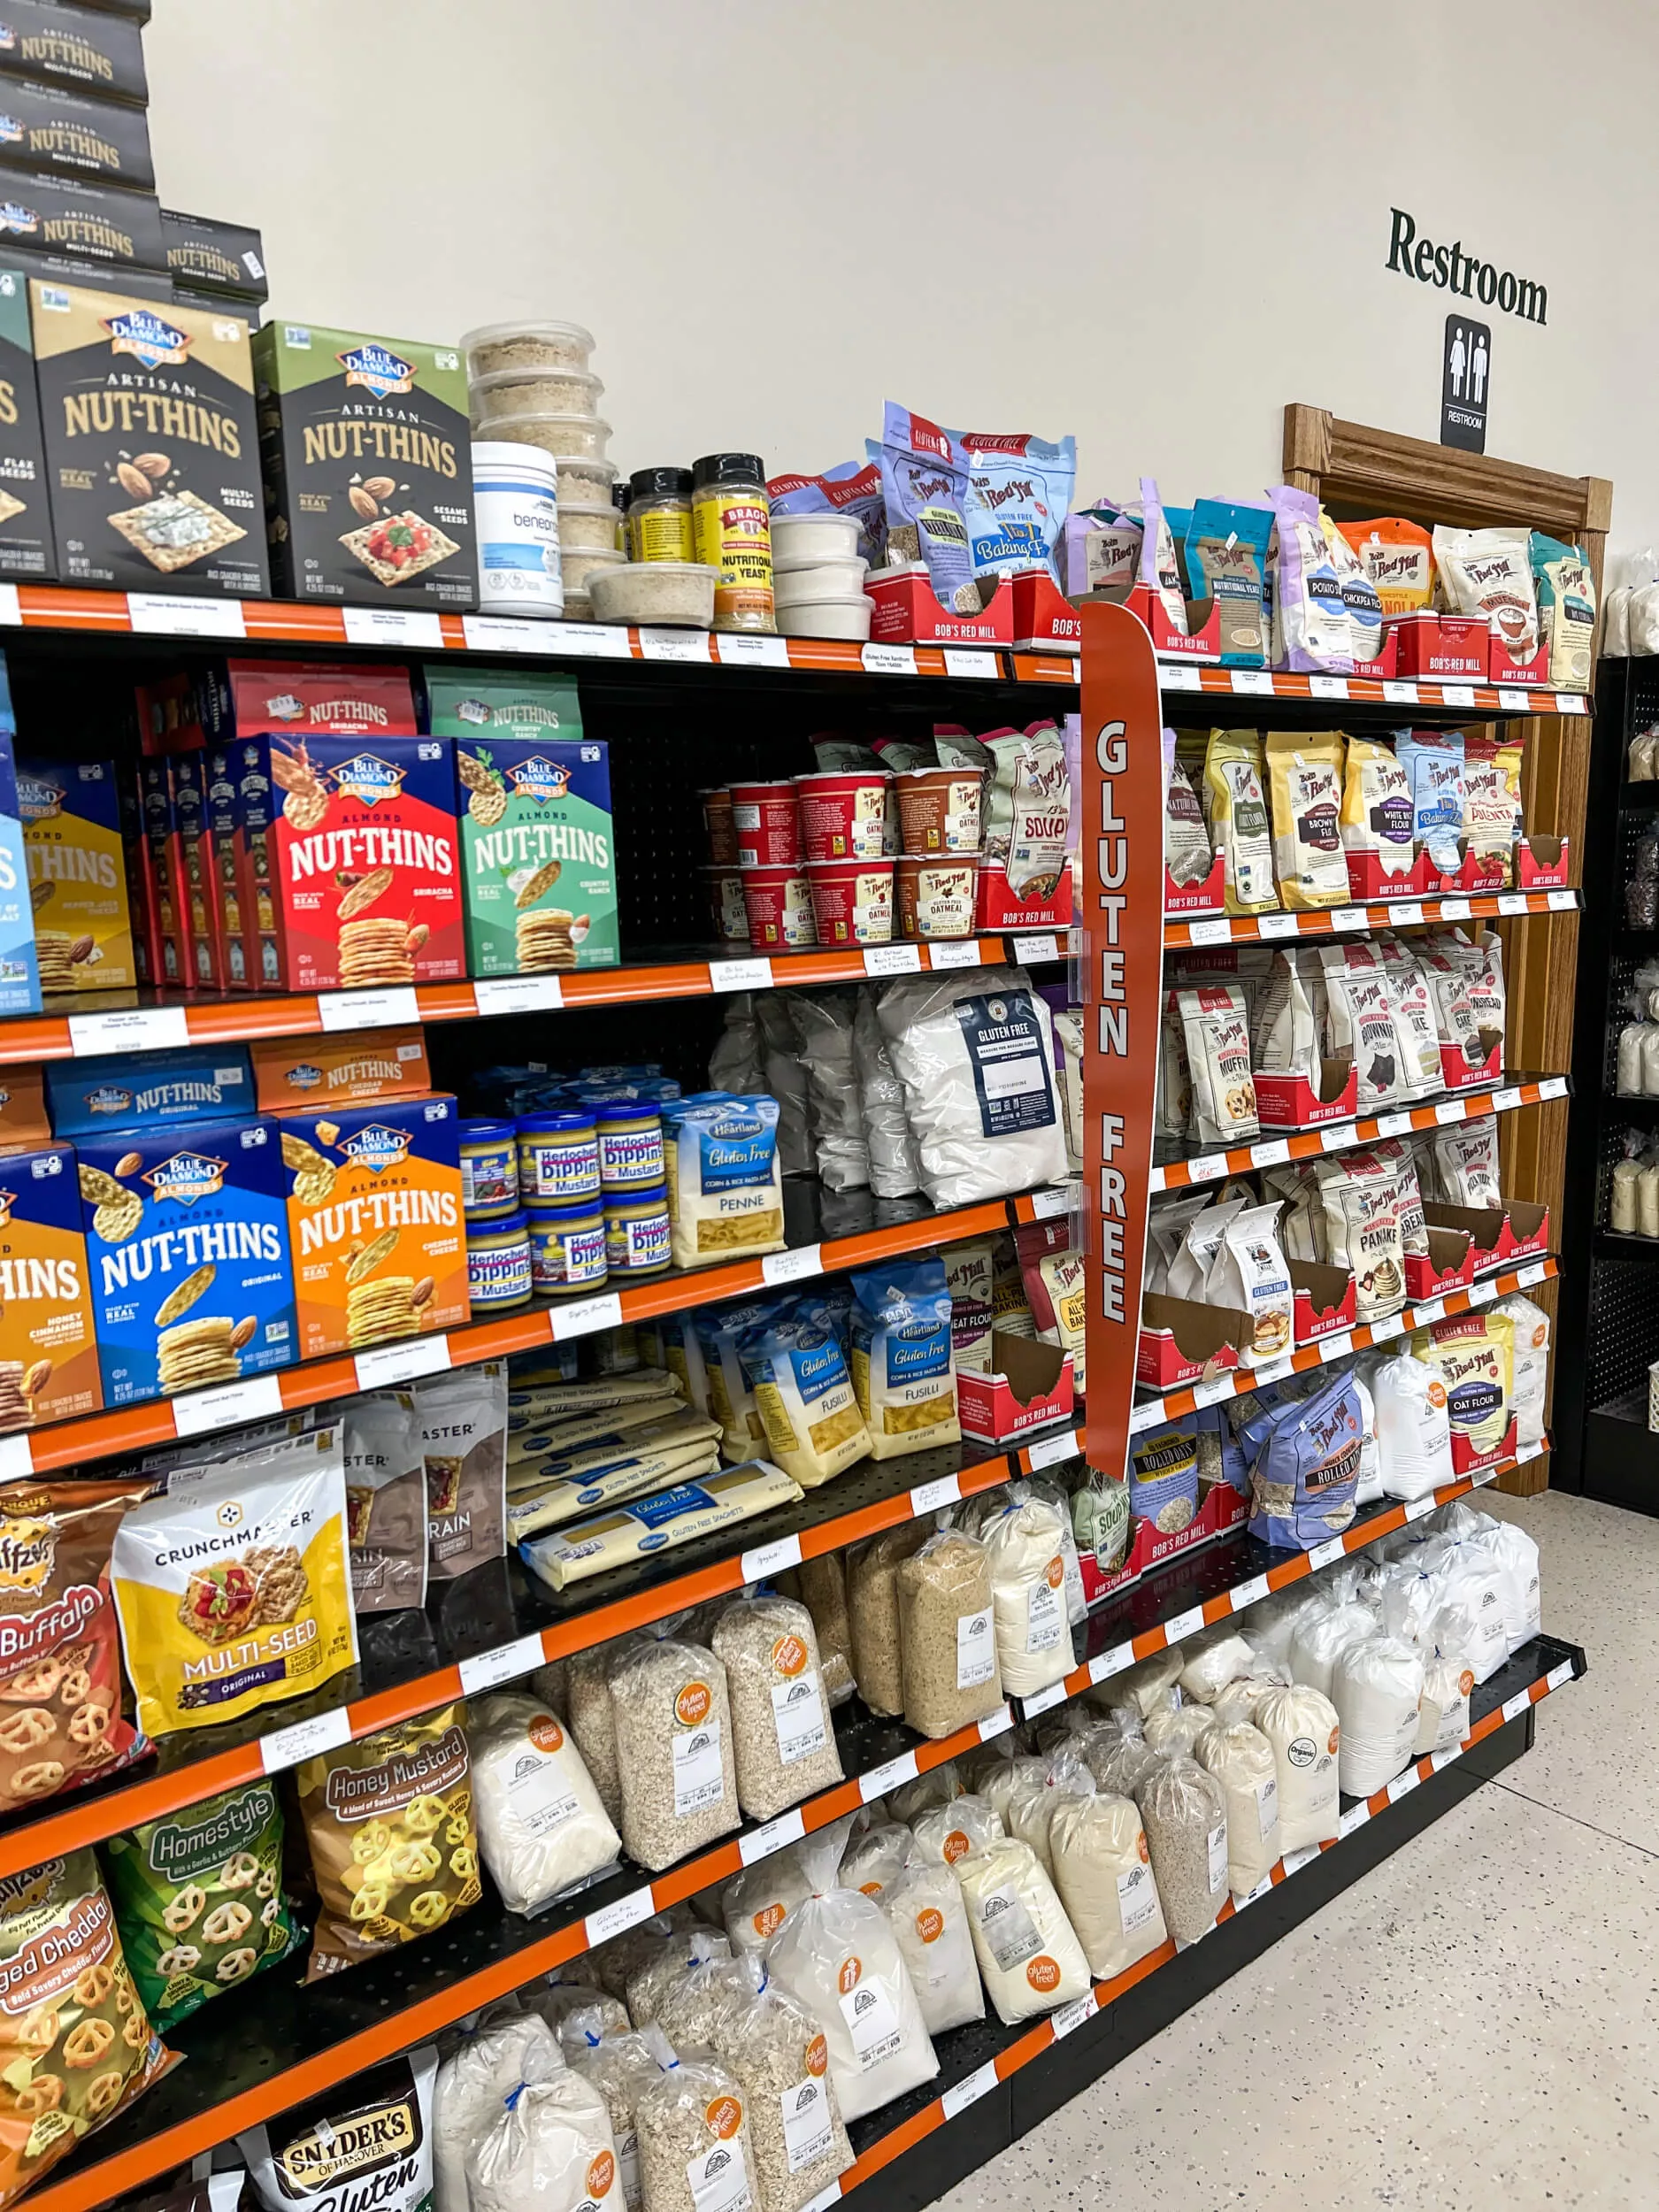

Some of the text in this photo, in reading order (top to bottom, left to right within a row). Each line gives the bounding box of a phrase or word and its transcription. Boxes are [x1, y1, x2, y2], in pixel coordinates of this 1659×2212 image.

[21, 36, 113, 81] NUT-THINS
[29, 128, 120, 169] NUT-THINS
[44, 219, 134, 257] NUT-THINS
[167, 249, 241, 280] NUT-THINS
[1385, 206, 1548, 326] Restroom
[129, 311, 165, 332] BLUE
[112, 321, 184, 348] DIAMOND
[362, 346, 392, 364] BLUE
[346, 355, 409, 377] DIAMOND
[107, 373, 197, 397] ARTISAN
[342, 403, 419, 424] ARTISAN
[1448, 410, 1482, 430] RESTROOM
[63, 390, 242, 459] NUT-THINS
[303, 420, 458, 480] NUT-THINS
[728, 507, 766, 523] BRAGG
[976, 540, 1031, 564] Baking
[739, 568, 766, 580] YEAST
[1343, 593, 1371, 608] CHICKPEA
[935, 624, 996, 638] BOB'S RED MILL
[1167, 636, 1210, 651] BOB'S RED MILL
[1430, 657, 1480, 671] BOB'S RED MILL
[1502, 671, 1538, 680] BOB'S RED MILL
[310, 700, 388, 726] NUT-THINS
[493, 705, 559, 728] NUT-THINS
[353, 760, 383, 773] BLUE
[526, 761, 553, 773] BLUE
[339, 768, 398, 784] DIAMOND
[513, 768, 565, 784] DIAMOND
[343, 784, 398, 798] ALMONDS
[517, 784, 565, 795] ALMONDS
[342, 813, 402, 823] ALMOND
[518, 811, 567, 821] ALMOND
[1385, 811, 1401, 821] WHITE
[1471, 807, 1514, 824] POLENTA
[1392, 820, 1410, 830] FLOUR
[289, 826, 453, 881] NUT-THINS
[474, 825, 609, 874] NUT-THINS
[413, 887, 454, 897] SRIRACHA
[1096, 720, 1128, 1057] GLUTEN
[1379, 884, 1414, 895] BOB'S RED MILL
[930, 902, 963, 914] OATMEAL
[1168, 895, 1212, 907] BOB'S RED MILL
[1002, 910, 1055, 924] BOB'S RED MILL
[978, 1022, 1030, 1042] GLUTEN FREE
[327, 1061, 403, 1090] NUT-THINS
[135, 1082, 222, 1114] NUT-THINS
[1309, 1105, 1347, 1121] BOB'S RED MILL
[361, 1131, 389, 1143] BLUE
[713, 1122, 761, 1136] Heartland
[348, 1138, 404, 1155] DIAMOND
[709, 1142, 772, 1168] Gluten Free
[170, 1159, 202, 1171] BLUE
[352, 1152, 403, 1165] ALMONDS
[154, 1166, 220, 1185] DIAMOND
[618, 1164, 661, 1179] Mustard
[159, 1181, 220, 1196] ALMONDS
[350, 1178, 409, 1194] ALMOND
[556, 1177, 599, 1194] Mustard
[719, 1194, 765, 1211] PENNE
[158, 1209, 225, 1228] ALMOND
[299, 1191, 457, 1256] NUT-THINS
[1099, 1112, 1128, 1325] FREE
[422, 1238, 458, 1251] CHEDDAR
[429, 1246, 458, 1256] CHEESE
[100, 1221, 282, 1296] NUT-THINS
[242, 1272, 283, 1287] ORIGINAL
[481, 1281, 528, 1297] Mustard
[1253, 1282, 1288, 1297] GLUTEN FREE
[106, 1309, 134, 1320] REAL
[992, 1297, 1028, 1316] BAKING
[47, 1311, 82, 1327] HONEY
[29, 1320, 84, 1340] CINNAMON
[902, 1322, 941, 1340] Heartland
[1435, 1324, 1480, 1340] GLUTEN FREE
[894, 1342, 946, 1367] Gluten Free
[905, 1384, 940, 1401] FUSILLI
[822, 1392, 848, 1413] FUSILLI
[1454, 1395, 1494, 1411] OAT FLOUR
[1013, 1403, 1061, 1429] BOB'S RED MILL
[1142, 1449, 1175, 1471] ROLLED
[1317, 1459, 1350, 1484] ROLLED
[672, 1506, 743, 1538] GLUTEN FREE SPAGHETTI
[1099, 1509, 1121, 1534] SOUP
[1152, 1528, 1206, 1558] BOB'S RED MILL
[1, 1594, 96, 1656] Buffalo
[184, 1619, 318, 1681] MULTI-SEED
[221, 1670, 267, 1694] ORIGINAL
[679, 1691, 707, 1711] gluten
[1291, 1746, 1314, 1759] Organic
[334, 1735, 464, 1801] Honey Mustard
[448, 1793, 469, 1811] GLUTEN
[160, 1794, 269, 1862] Homestyle
[0, 1954, 39, 1991] ged
[41, 1898, 108, 1966] Cheddar
[1027, 1965, 1055, 1978] gluten
[12, 1992, 30, 2006] Bold
[32, 1974, 61, 1995] Savory
[289, 2110, 406, 2175] SNYDER'S
[319, 2144, 385, 2176] OF HANOVER
[588, 2162, 612, 2187] gluten
